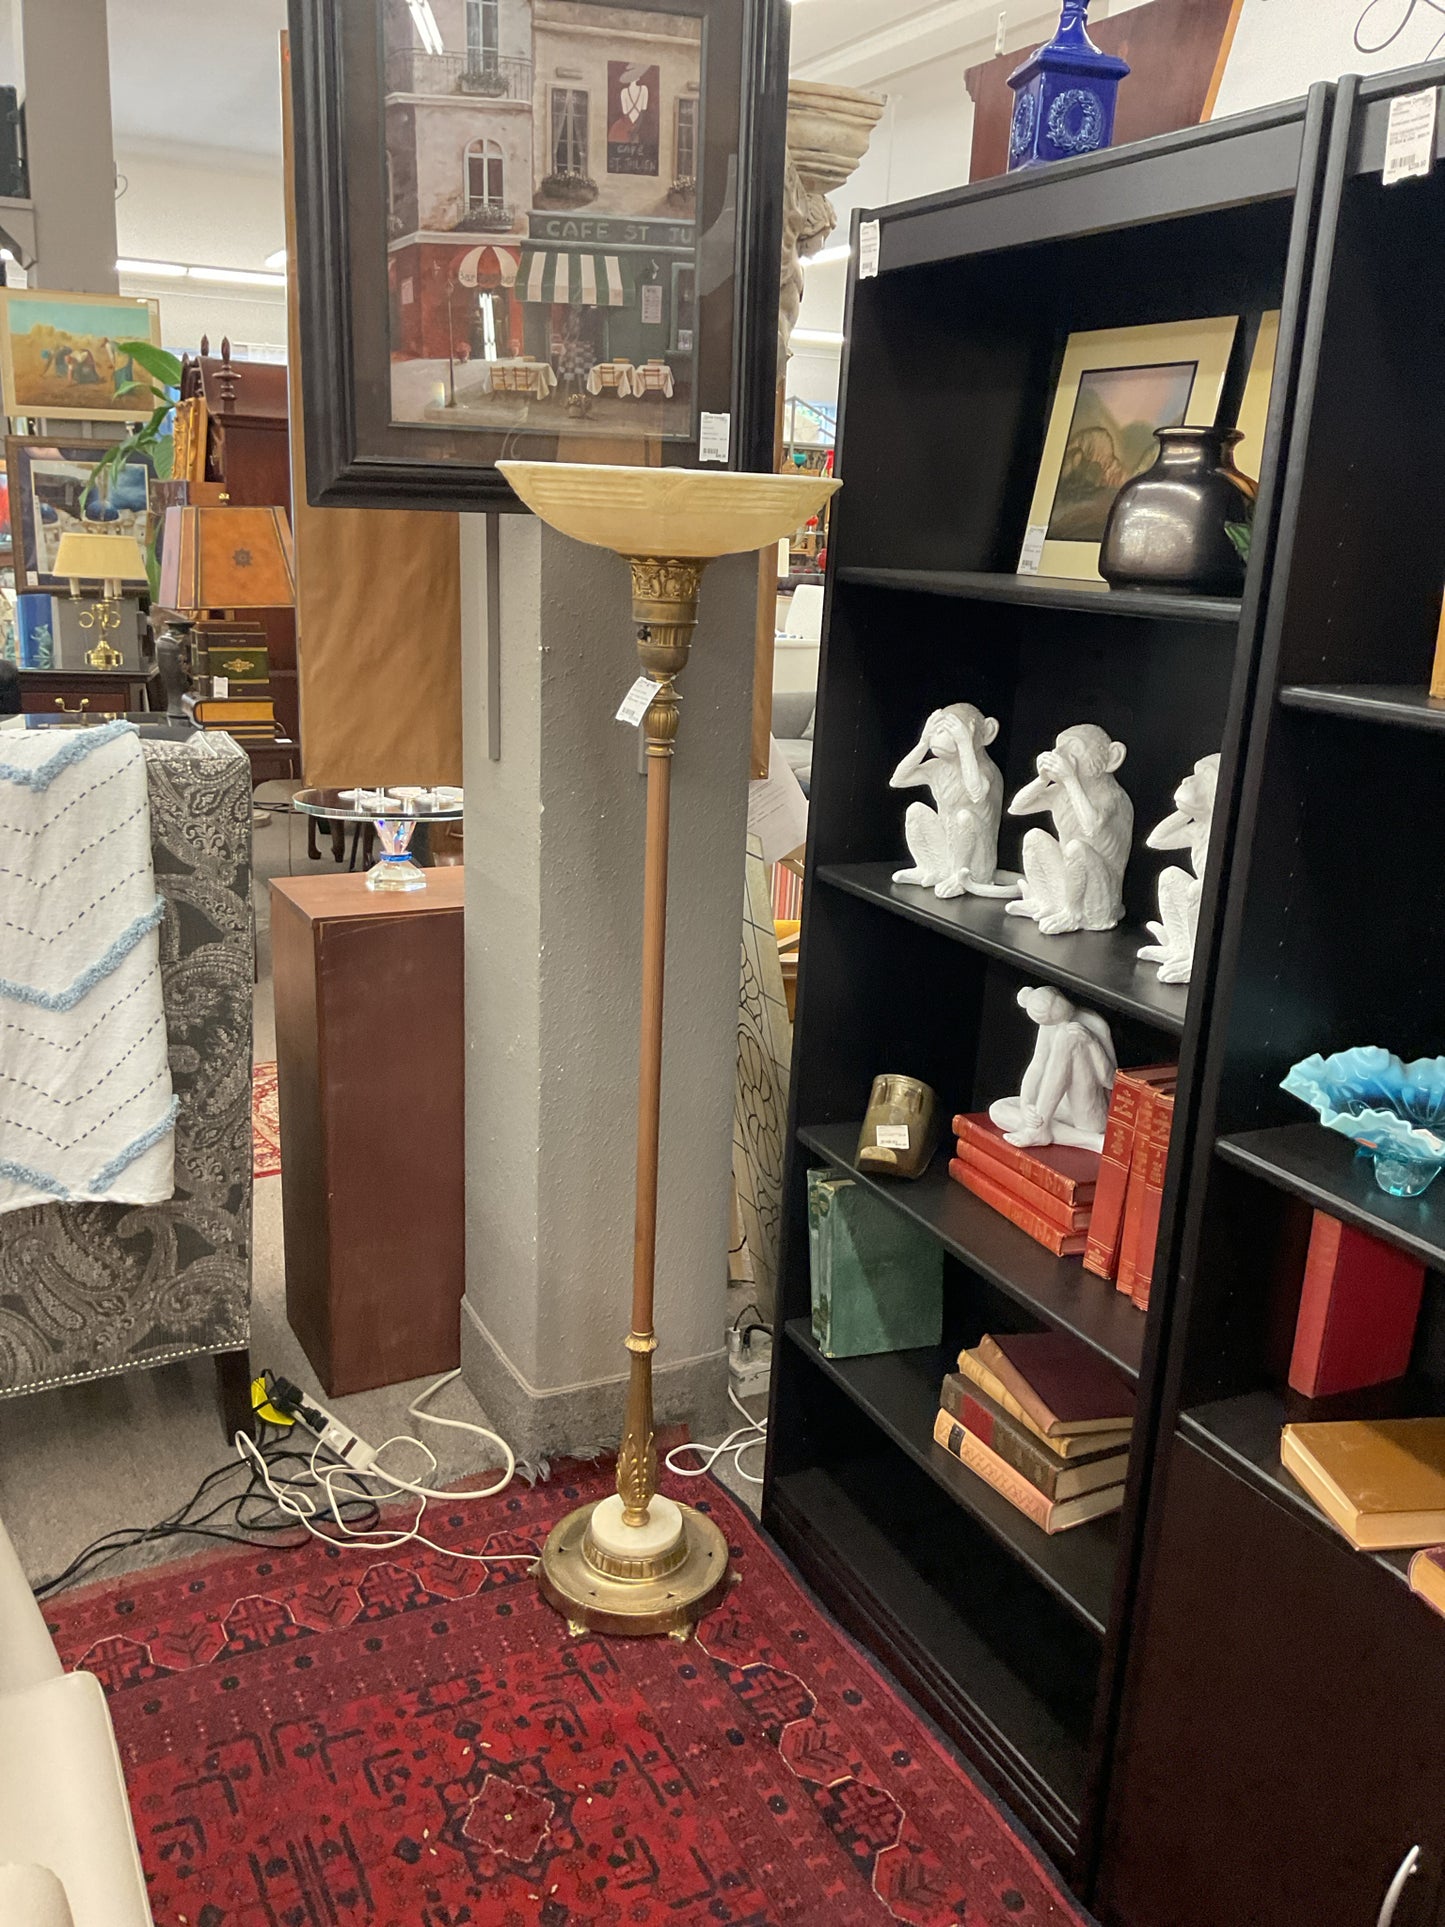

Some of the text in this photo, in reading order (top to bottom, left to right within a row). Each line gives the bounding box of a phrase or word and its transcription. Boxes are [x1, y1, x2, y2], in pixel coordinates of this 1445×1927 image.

[546, 220, 694, 245] CAFE ST JU
